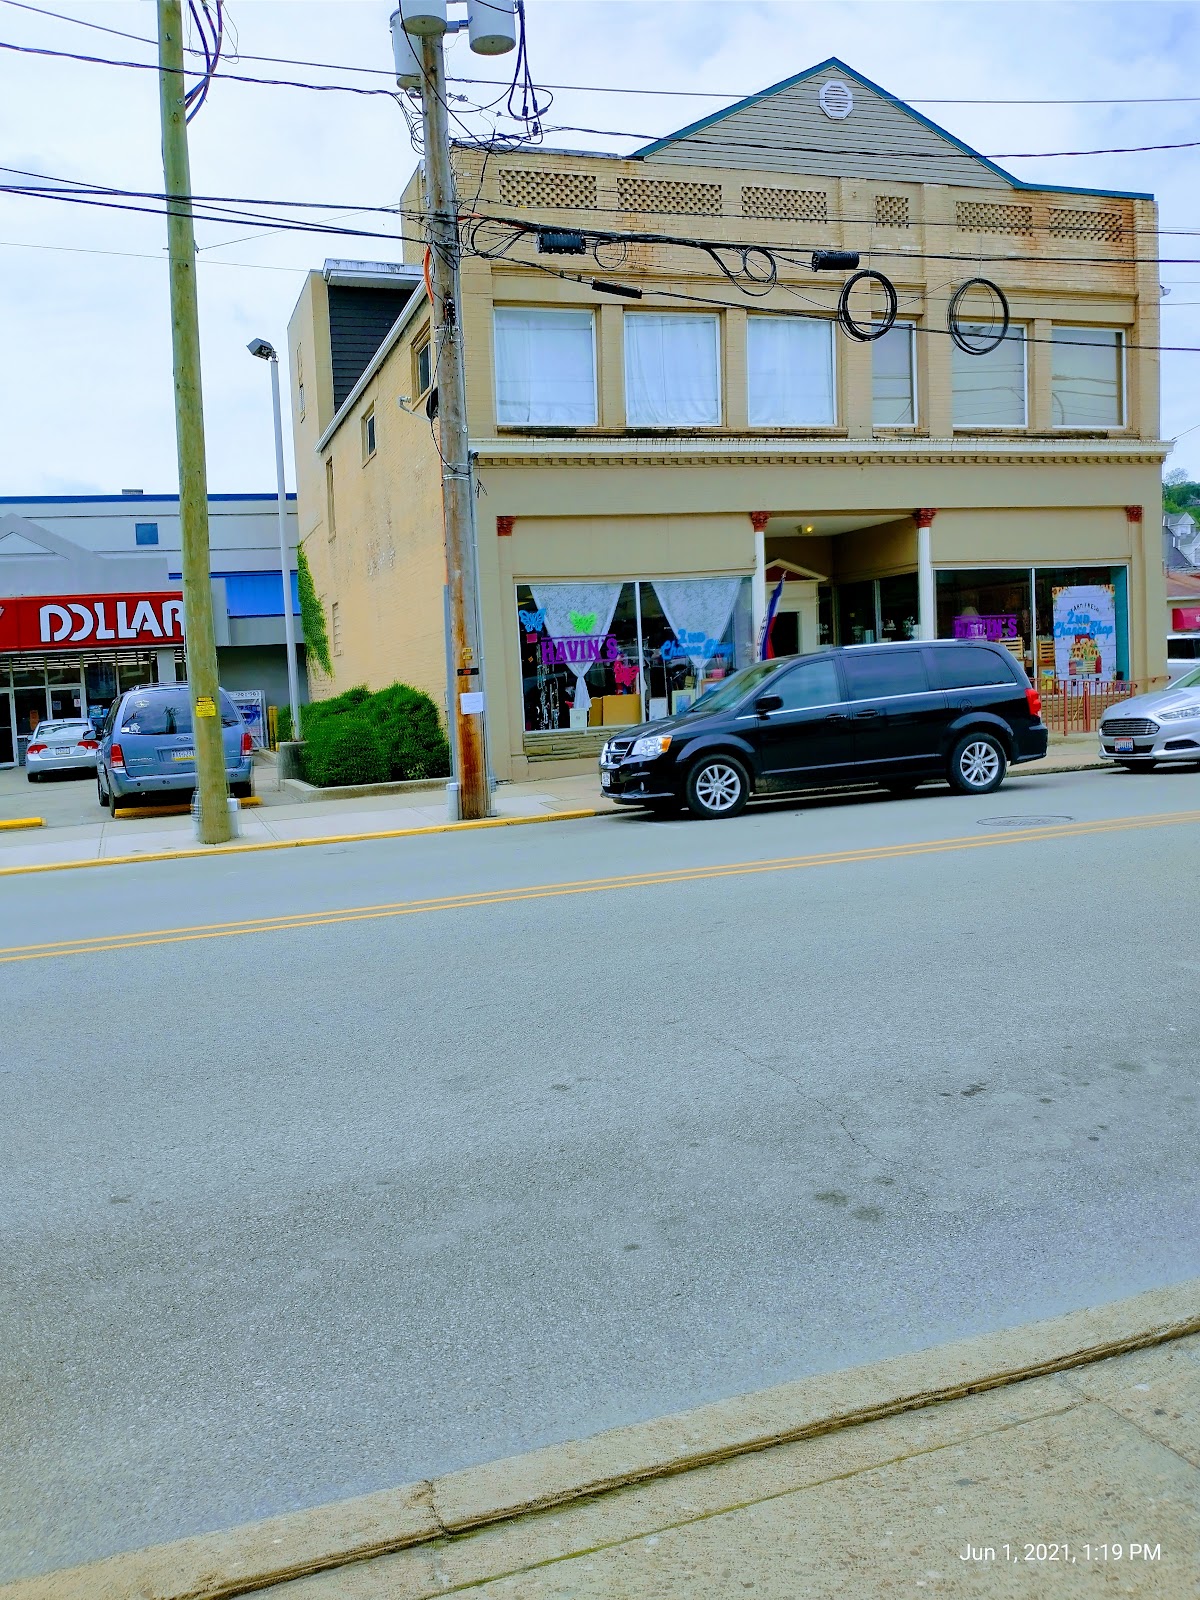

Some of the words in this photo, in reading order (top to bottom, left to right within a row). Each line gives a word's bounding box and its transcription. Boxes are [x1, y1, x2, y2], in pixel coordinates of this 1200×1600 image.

[39, 600, 184, 643] DOLLAR
[1053, 621, 1087, 638] Chance
[1089, 620, 1113, 640] Shop
[541, 637, 618, 662] HAVIN'S
